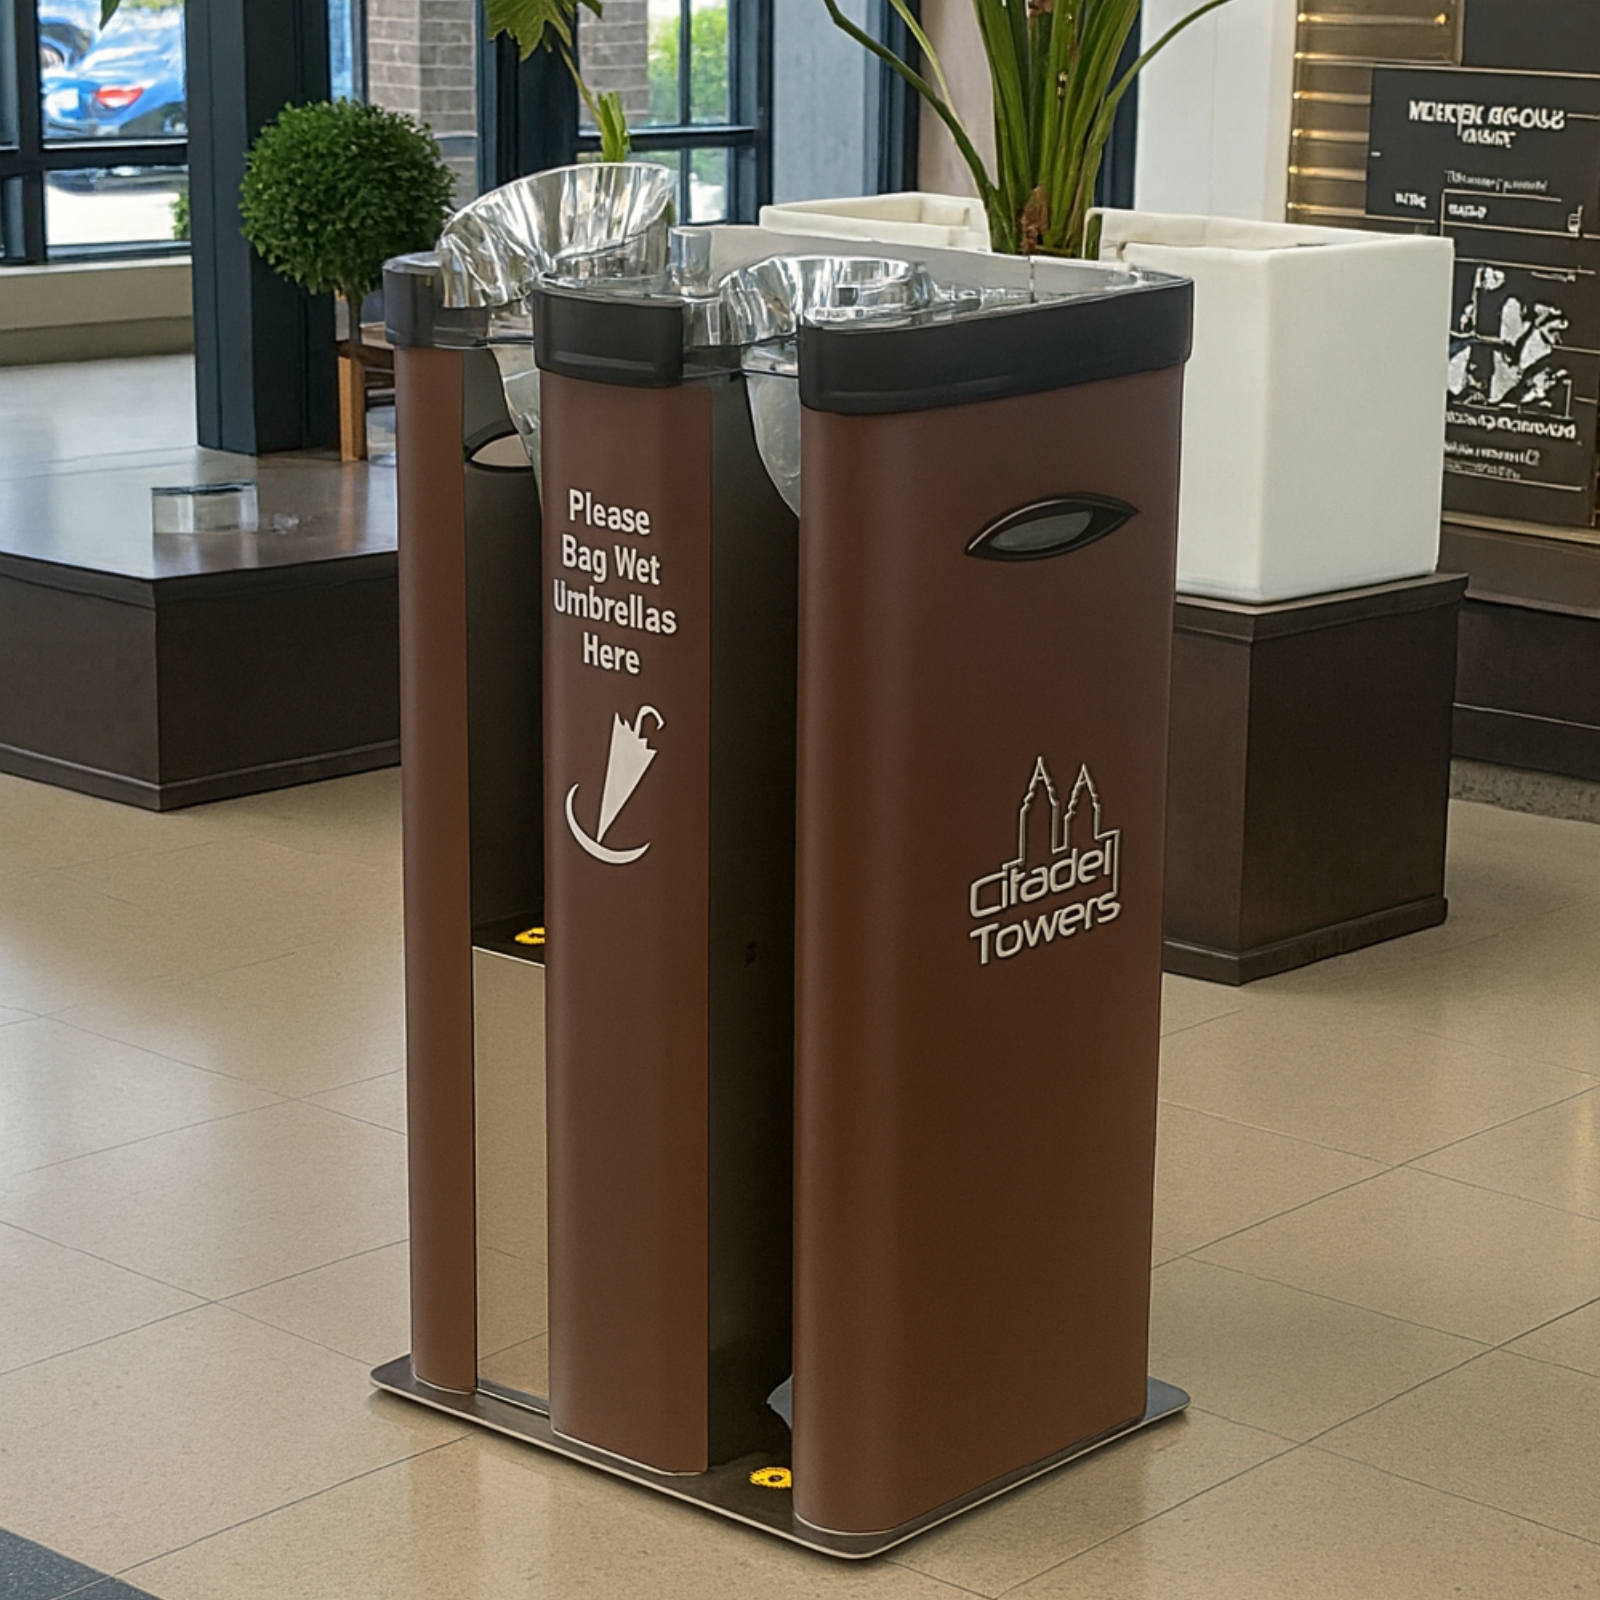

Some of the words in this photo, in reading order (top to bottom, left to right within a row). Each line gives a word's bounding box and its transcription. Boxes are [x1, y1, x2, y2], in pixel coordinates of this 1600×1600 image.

[569, 488, 651, 536] Please
[562, 533, 607, 583] Bag
[614, 545, 661, 586] Wet
[553, 578, 677, 635] Umbrellas
[583, 631, 640, 675] Here
[970, 838, 1113, 918] Citadel
[969, 891, 1121, 965] Towers
